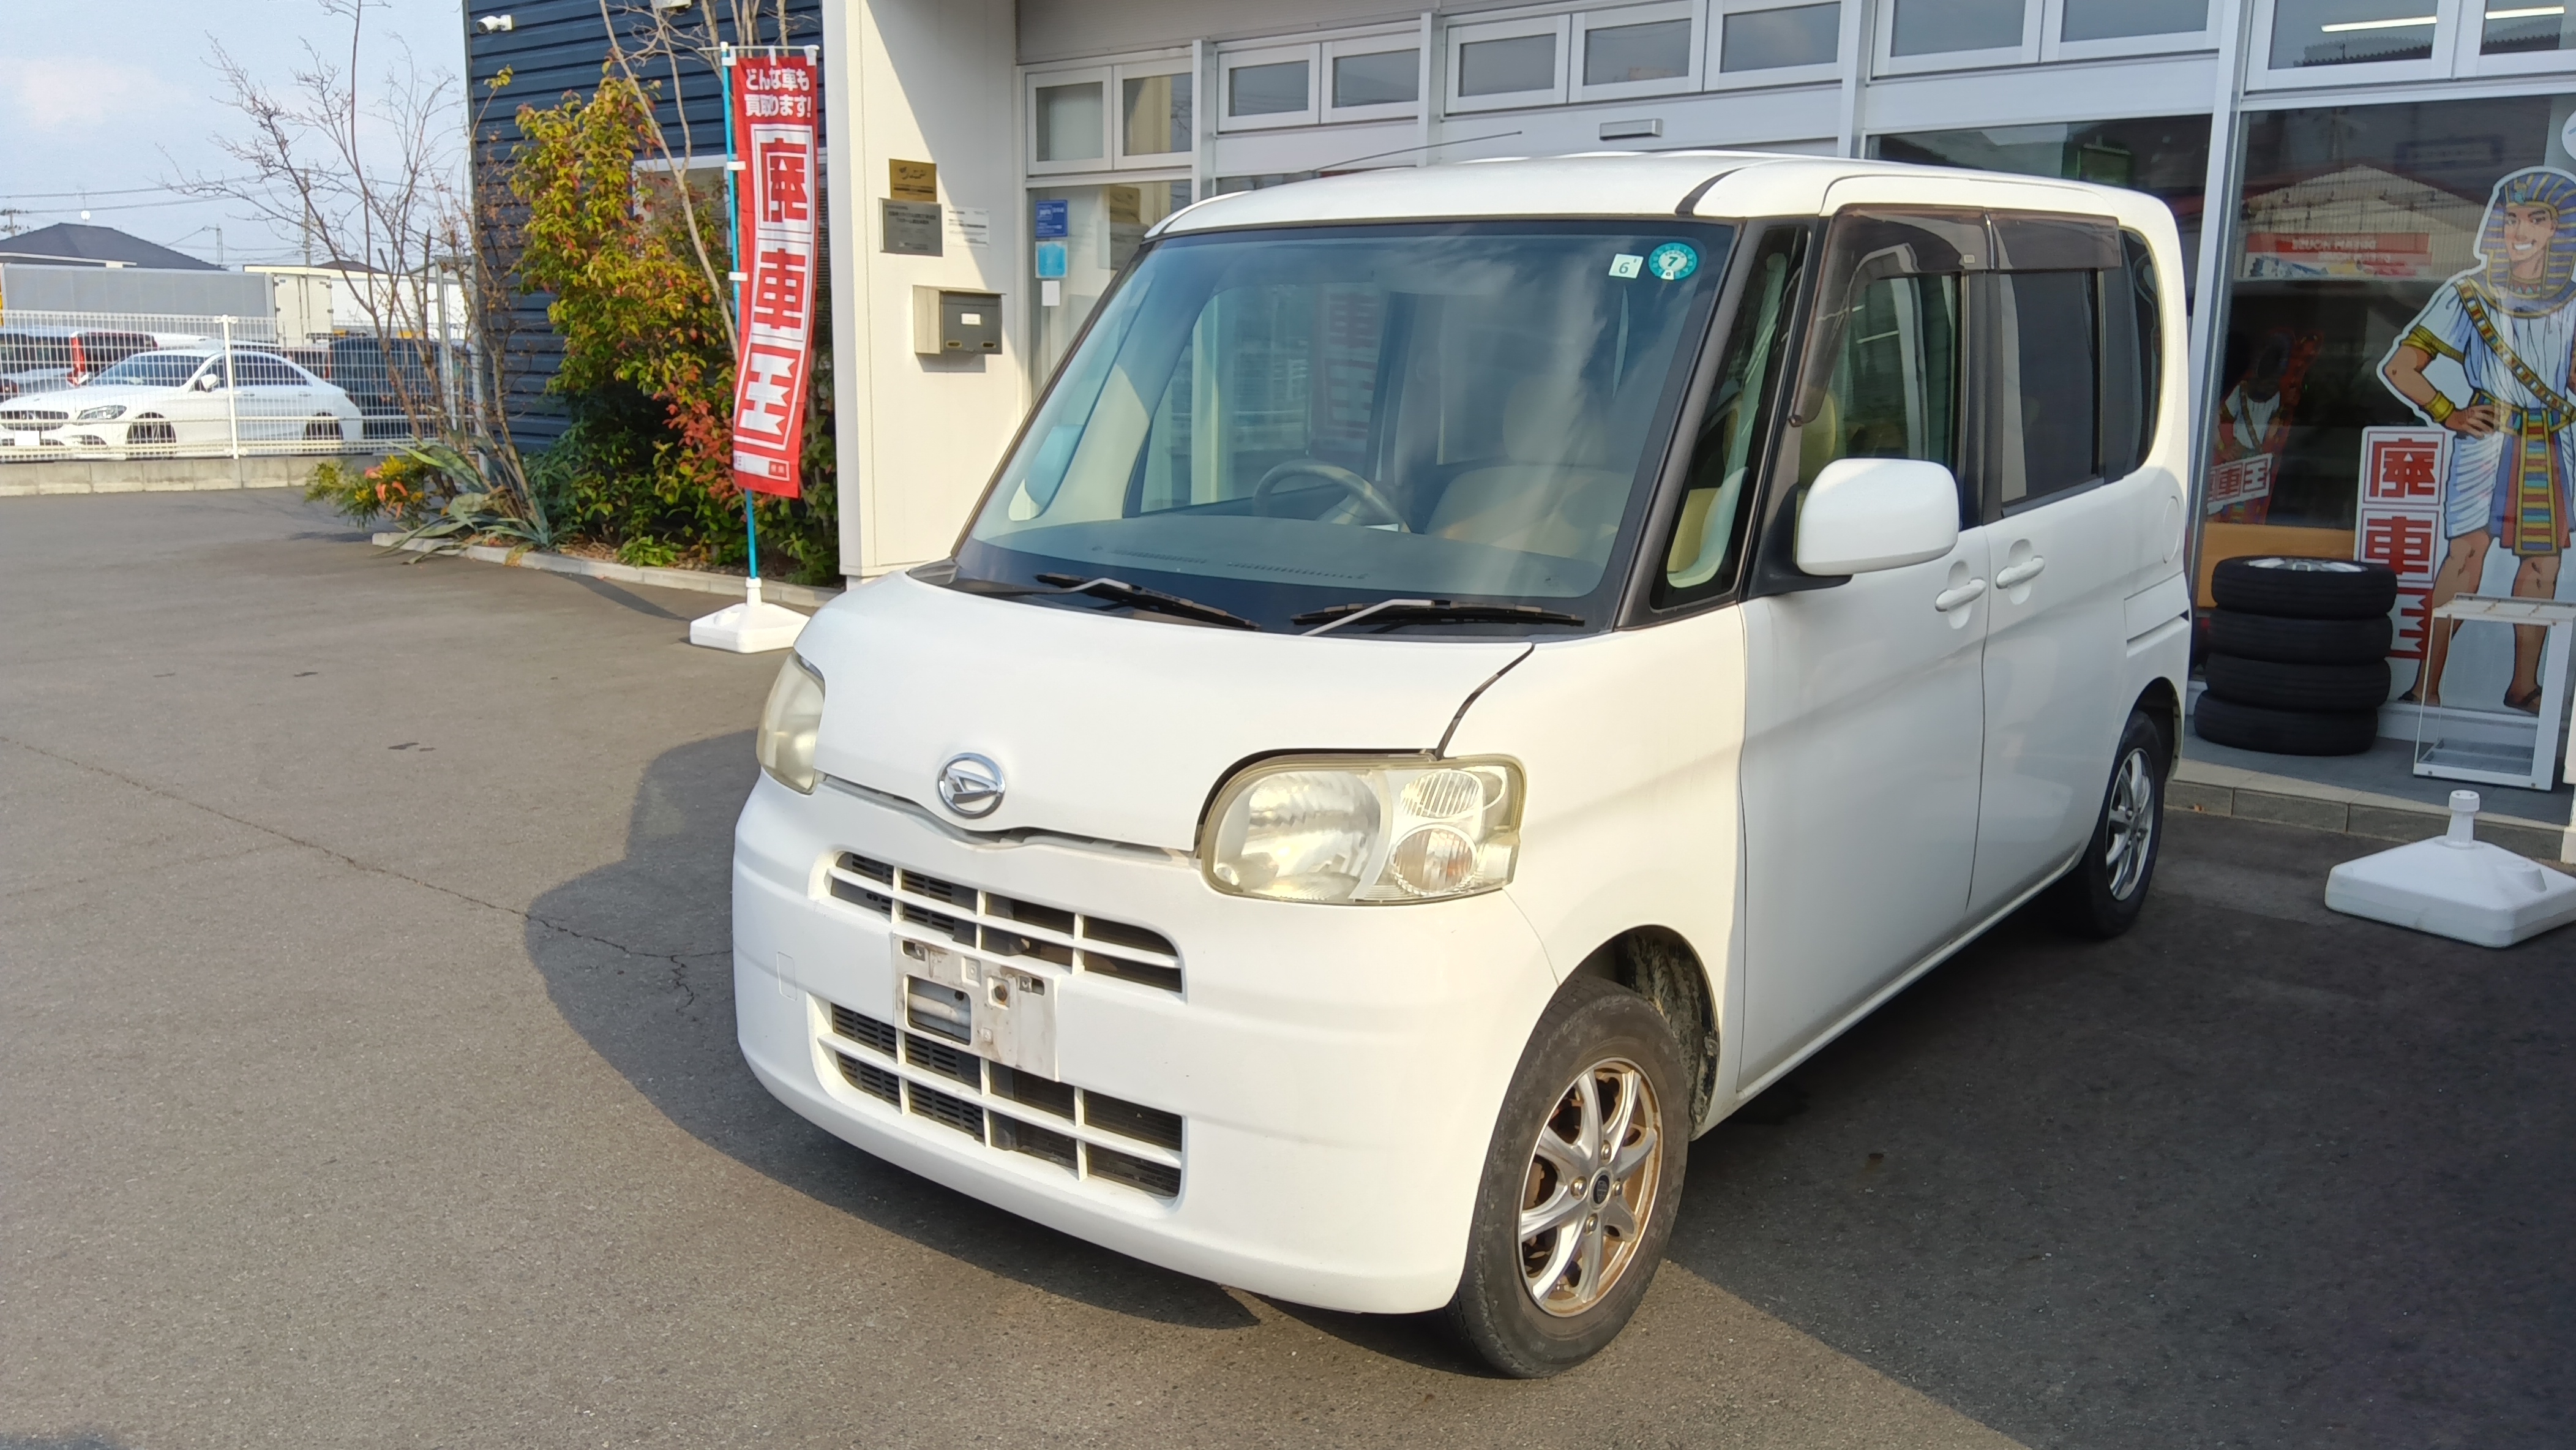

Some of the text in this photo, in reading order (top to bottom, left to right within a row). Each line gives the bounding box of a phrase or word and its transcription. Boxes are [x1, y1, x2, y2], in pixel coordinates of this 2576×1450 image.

[746, 68, 810, 91] どんな車も
[1619, 262, 1630, 274] 6
[1668, 257, 1679, 267] 7
[738, 138, 807, 436] 廃車王
